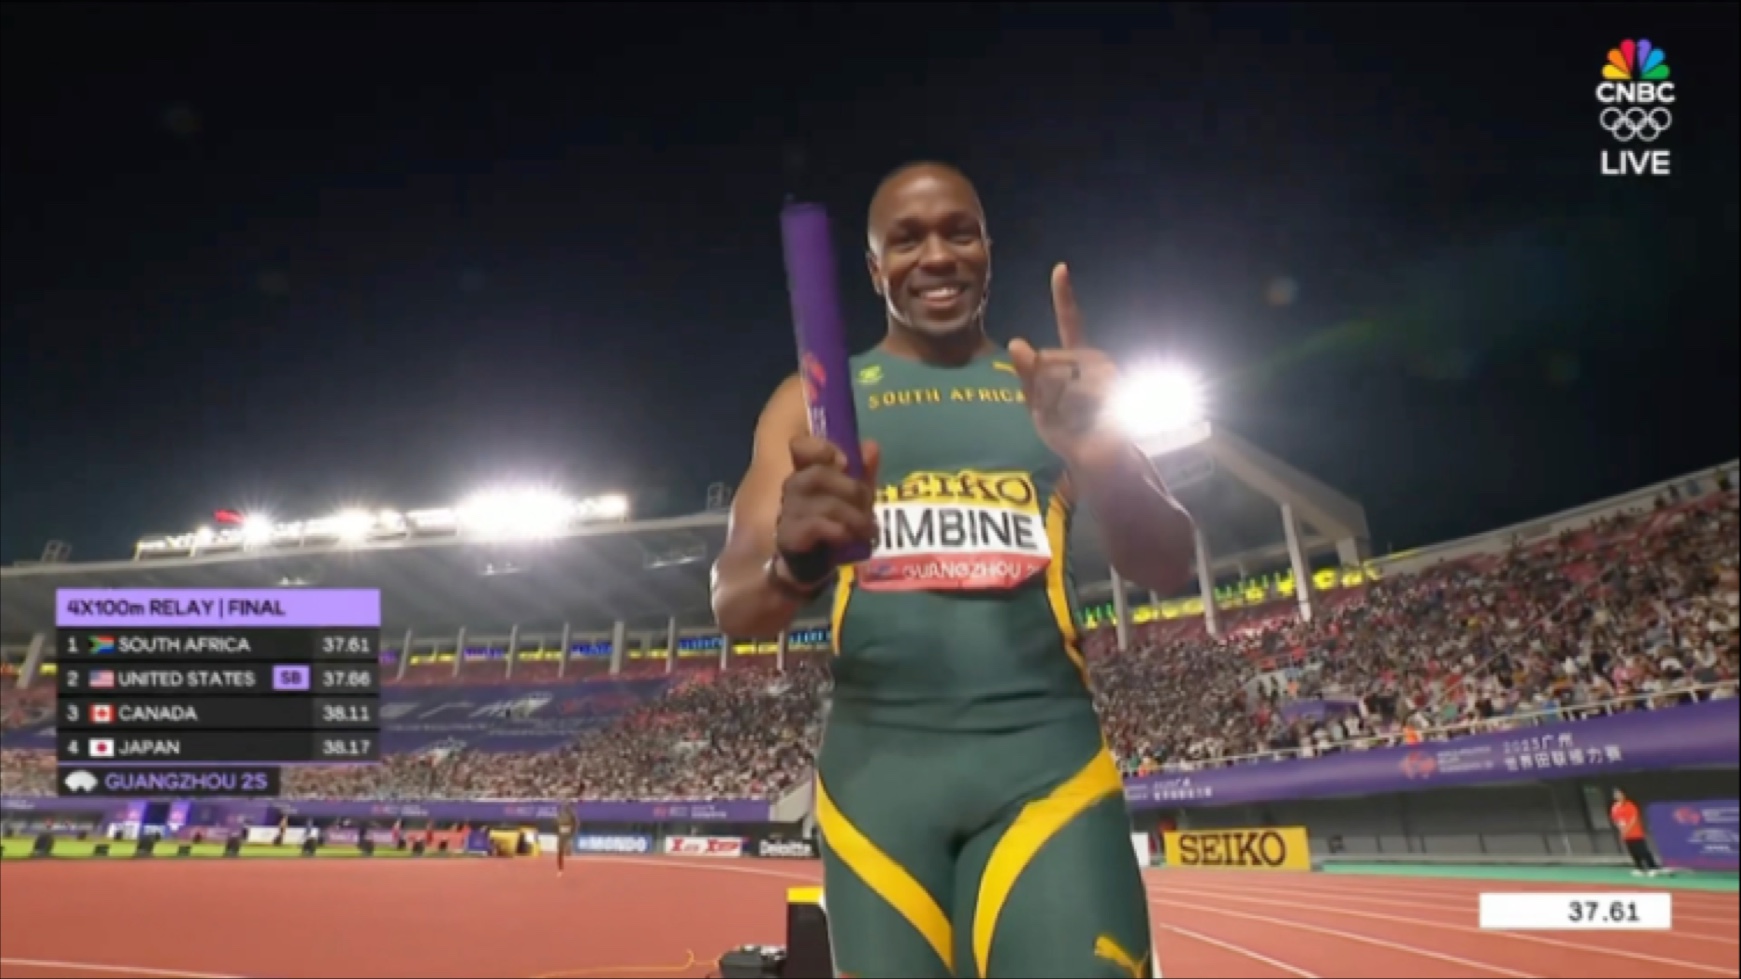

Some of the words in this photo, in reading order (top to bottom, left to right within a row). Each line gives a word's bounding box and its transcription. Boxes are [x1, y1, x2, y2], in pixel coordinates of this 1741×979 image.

[868, 388, 942, 410] SOUTH
[950, 387, 1027, 402] AFRICA
[903, 561, 1021, 579] GUANGZHOU
[1178, 831, 1286, 866] SEIKO
